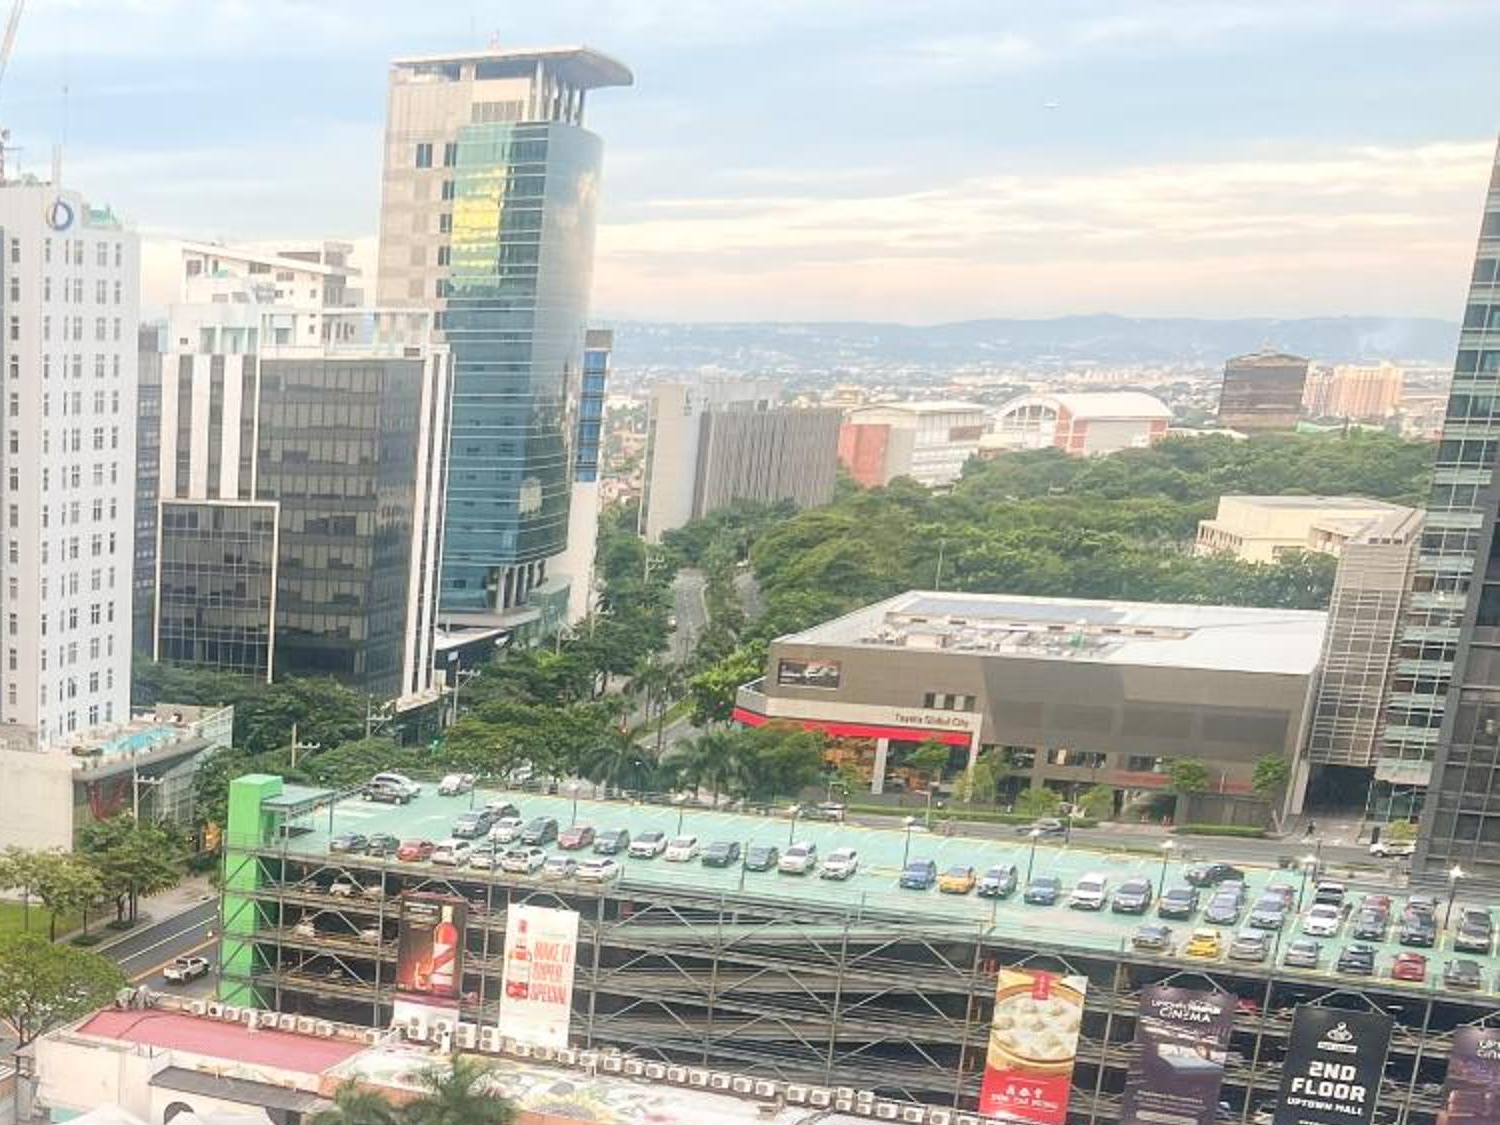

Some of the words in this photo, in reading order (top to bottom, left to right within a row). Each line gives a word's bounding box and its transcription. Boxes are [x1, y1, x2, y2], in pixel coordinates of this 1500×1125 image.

[1160, 1007, 1211, 1022] CINEMA
[1308, 1061, 1357, 1081] 2ND
[1291, 1077, 1367, 1102] FLOOR
[1287, 1097, 1333, 1111] UPTOWN
[1335, 1104, 1364, 1116] MALL
